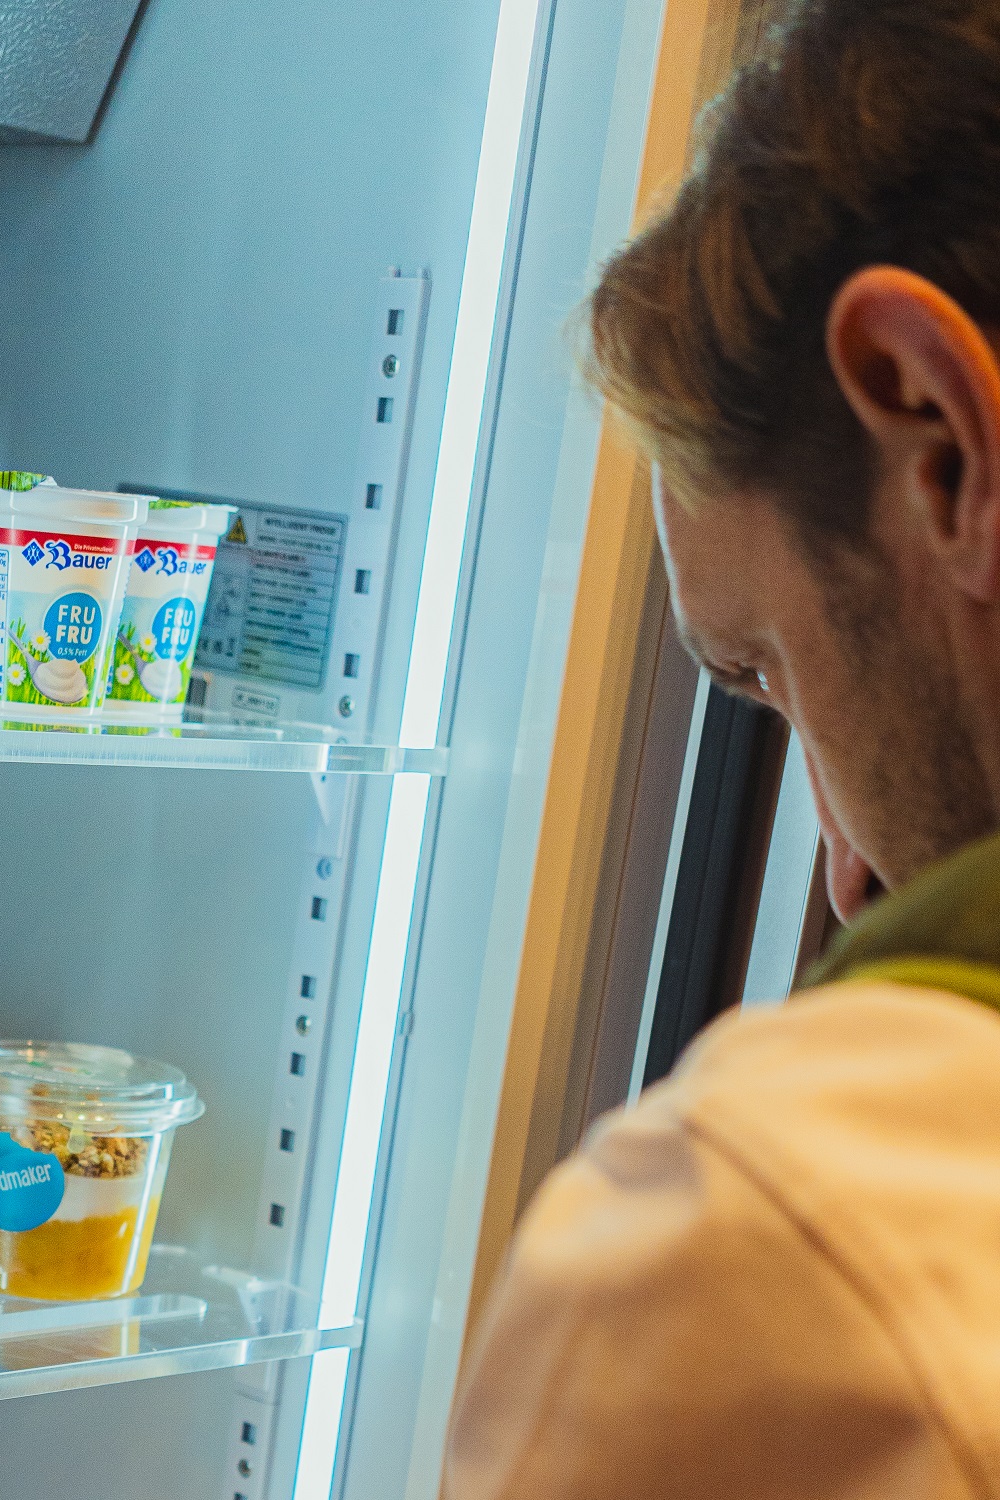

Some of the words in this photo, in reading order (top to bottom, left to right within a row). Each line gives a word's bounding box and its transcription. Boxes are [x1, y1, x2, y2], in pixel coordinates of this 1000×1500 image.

[45, 541, 112, 571] Bauer
[58, 605, 95, 625] FRU
[164, 608, 192, 627] FRU
[56, 625, 93, 645] FRU
[162, 627, 189, 645] FRU
